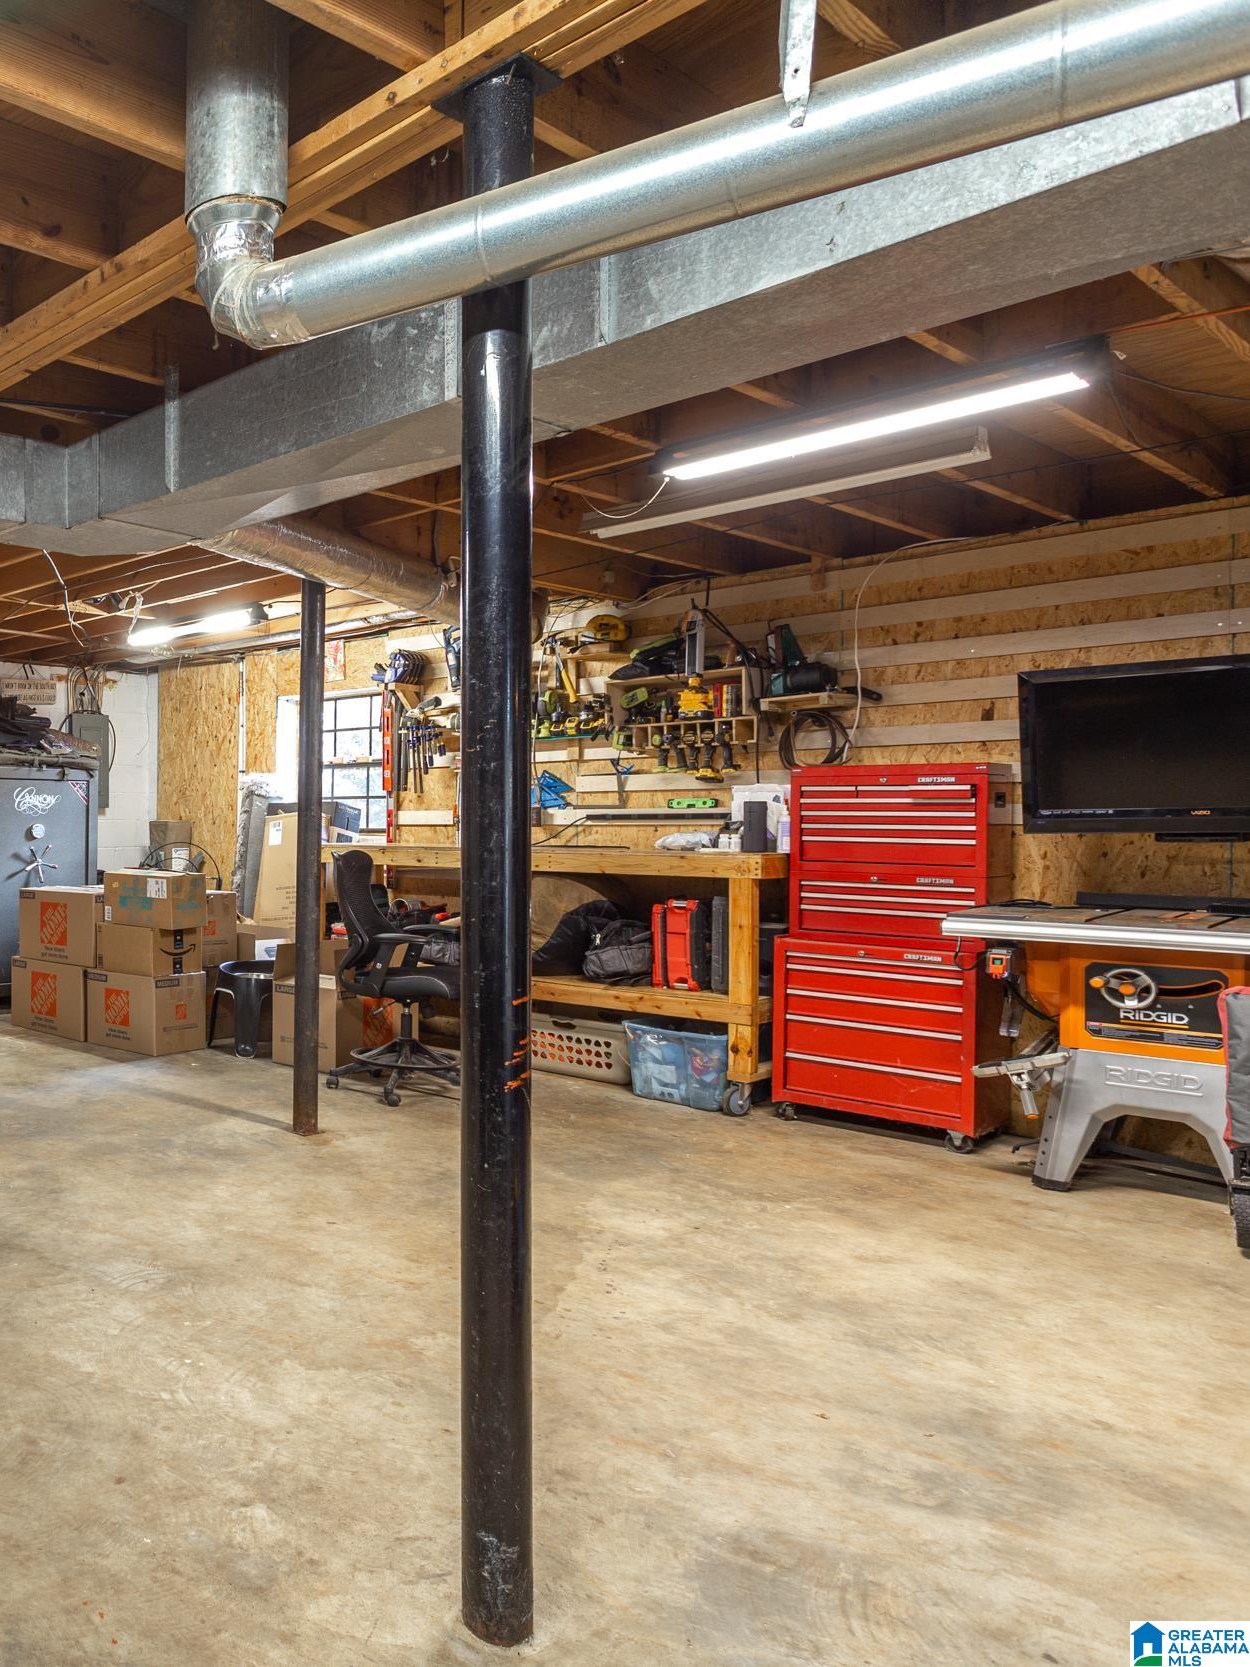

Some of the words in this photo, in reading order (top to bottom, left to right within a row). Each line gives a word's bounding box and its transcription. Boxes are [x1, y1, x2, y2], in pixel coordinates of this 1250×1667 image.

[917, 776, 956, 784] CRAFTSMAN
[915, 876, 955, 885] CRAFTSMAN
[903, 952, 943, 963] CRAFTSMAN
[1119, 1008, 1190, 1025] RIDGID
[1104, 1065, 1203, 1090] RIDGID
